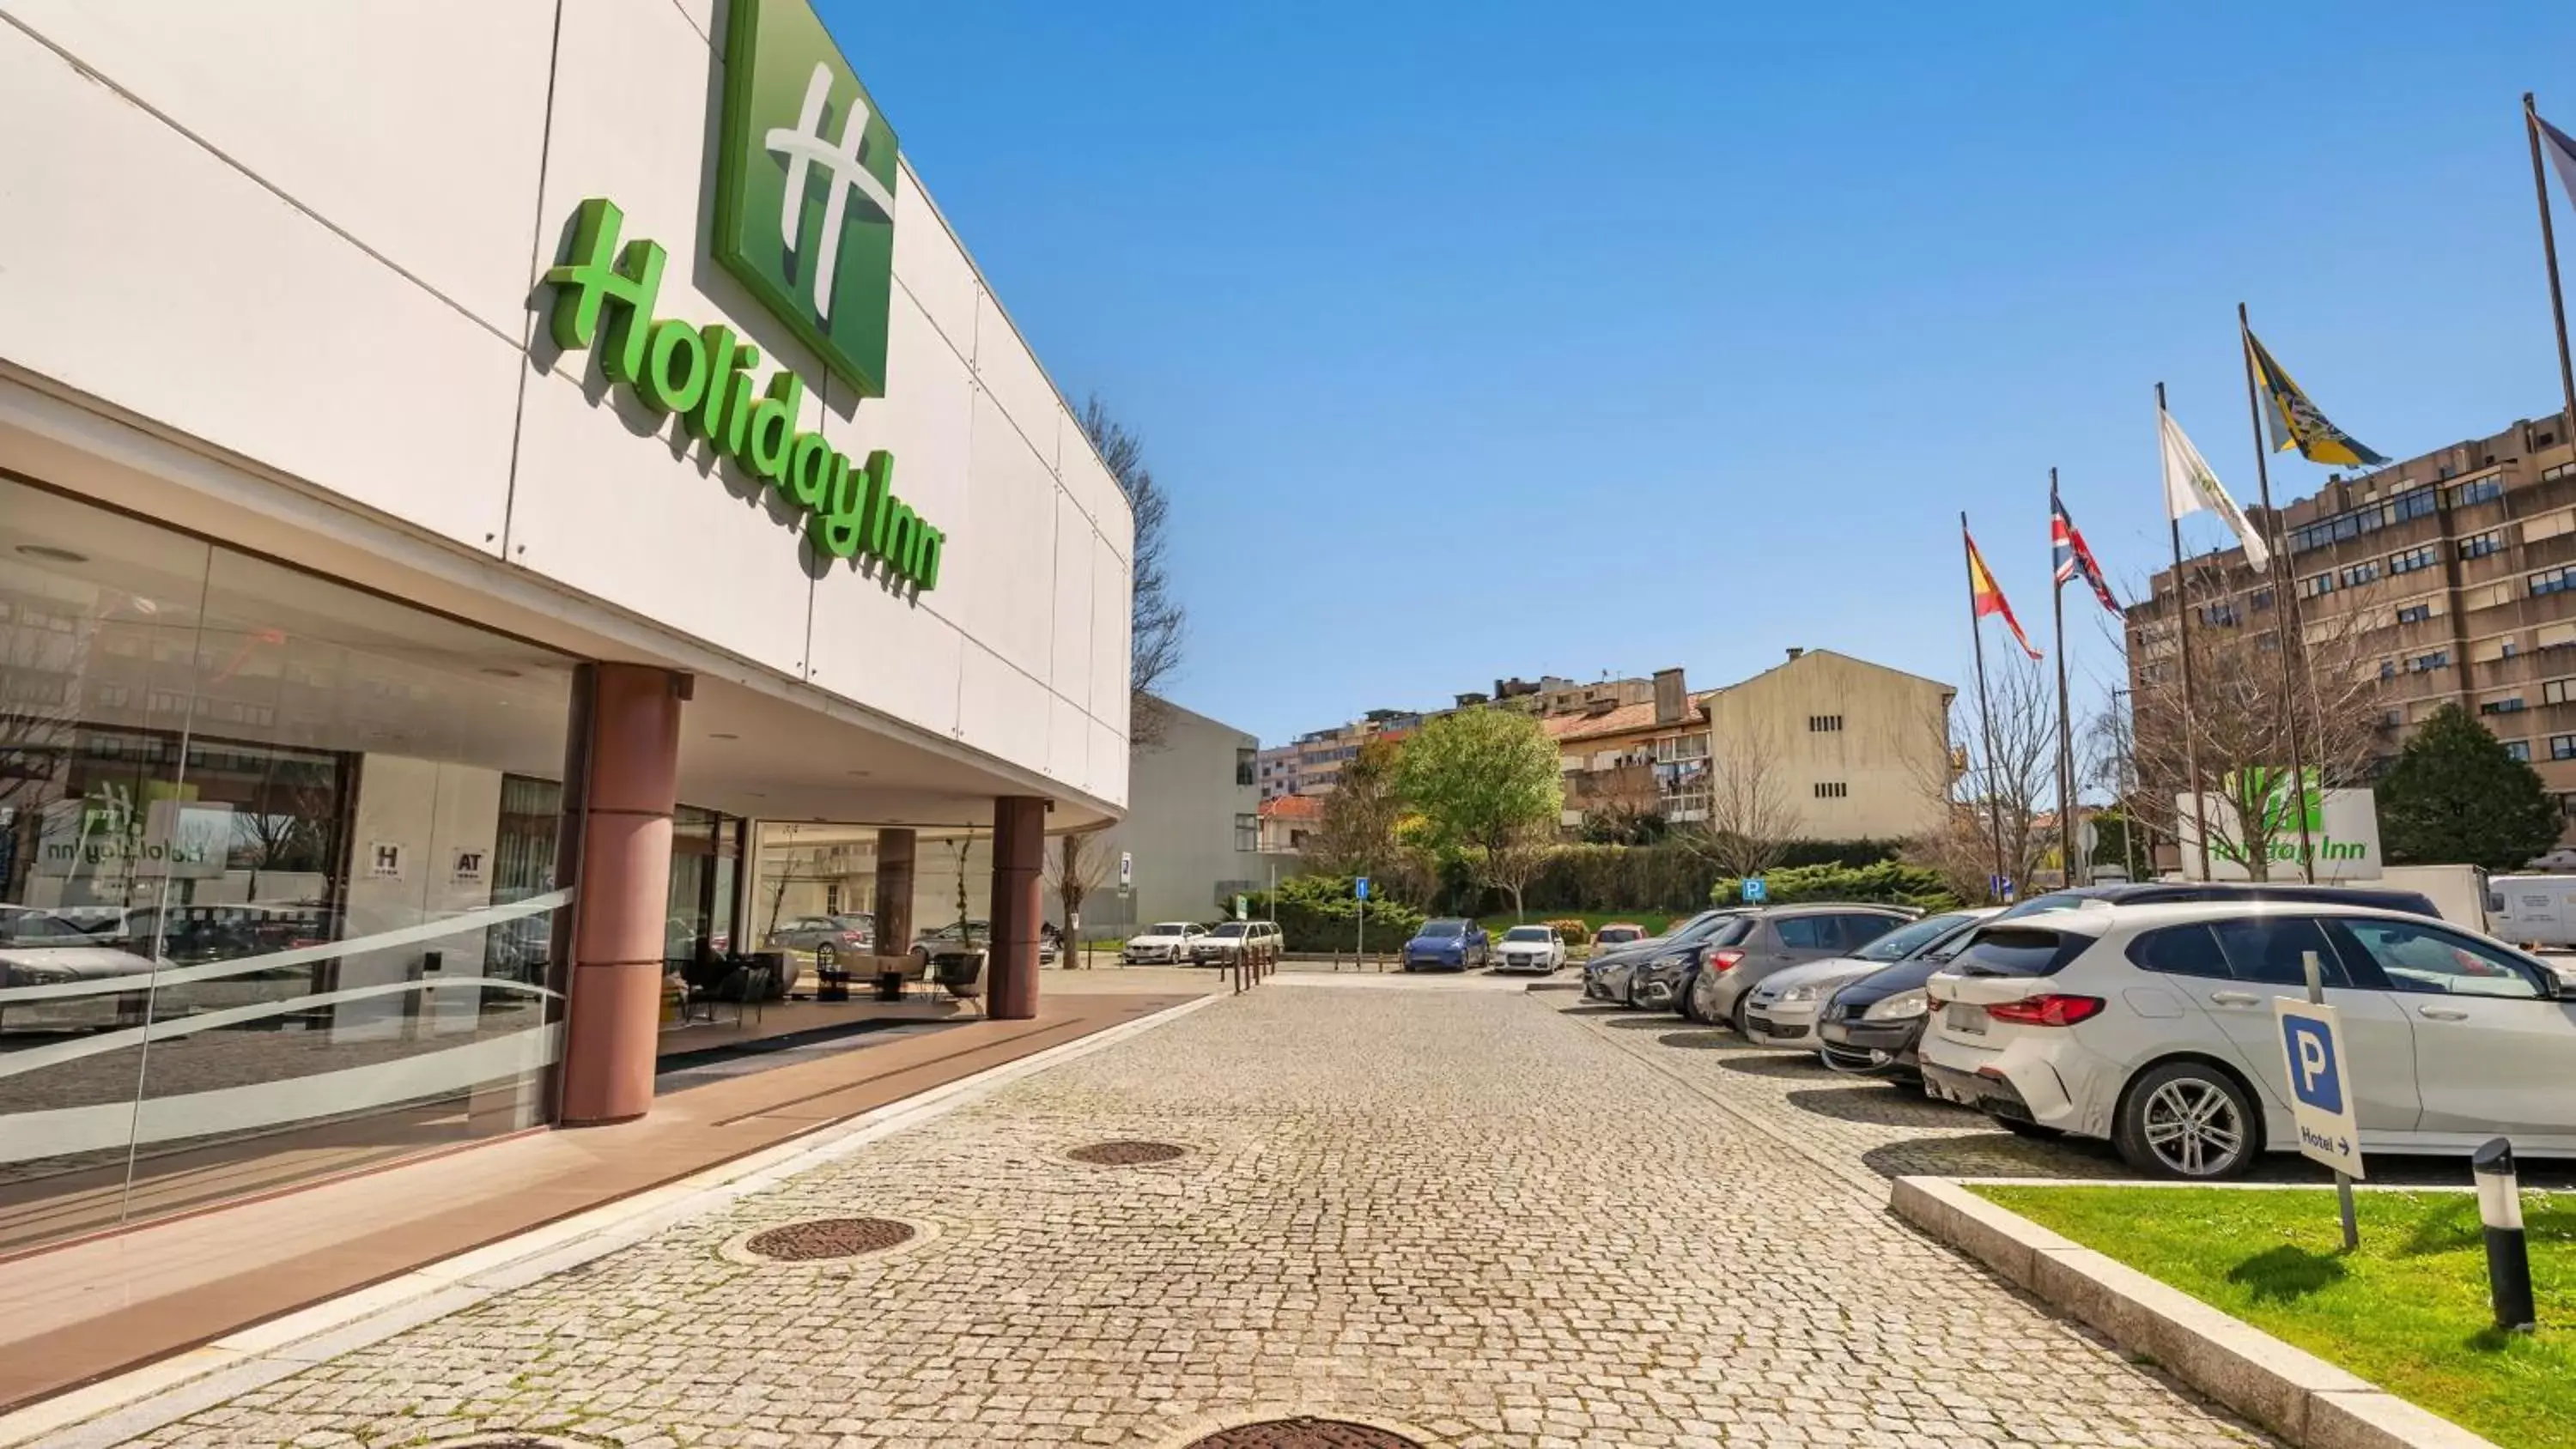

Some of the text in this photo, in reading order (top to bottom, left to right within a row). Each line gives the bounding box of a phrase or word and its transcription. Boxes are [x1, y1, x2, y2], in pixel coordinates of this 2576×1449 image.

[547, 197, 943, 591] Holiday Inn
[377, 846, 398, 868] H
[2321, 835, 2366, 860] Inn
[459, 853, 482, 871] AT
[1747, 882, 1759, 897] P
[2296, 1030, 2326, 1093] P
[2301, 1125, 2334, 1153] Hotel
